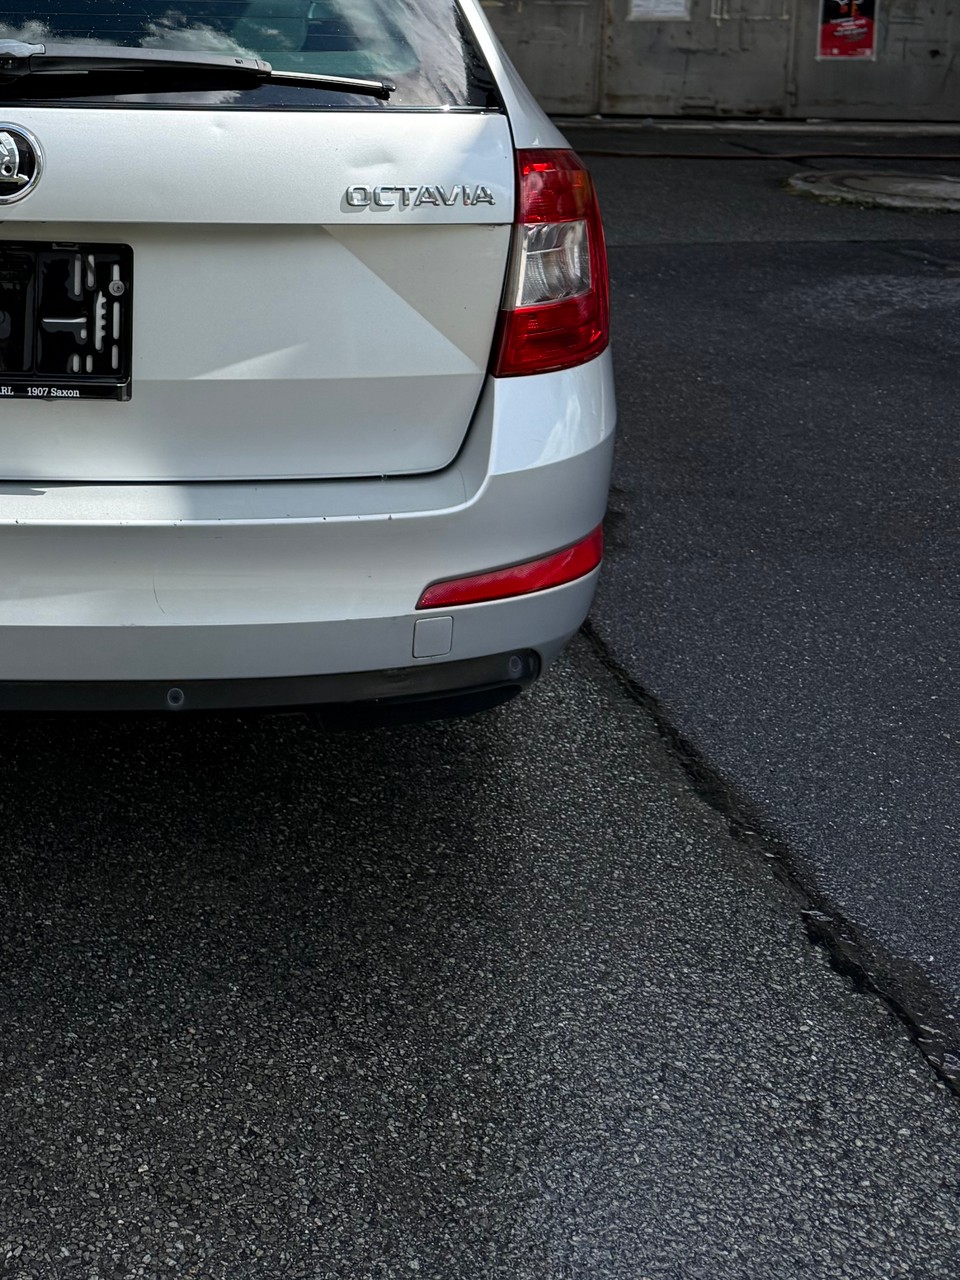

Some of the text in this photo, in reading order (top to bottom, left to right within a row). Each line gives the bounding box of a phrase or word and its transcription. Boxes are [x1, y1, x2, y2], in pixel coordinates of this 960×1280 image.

[346, 184, 496, 207] OCTAVIA
[27, 387, 49, 397] 1907
[50, 387, 80, 397] Saxon
